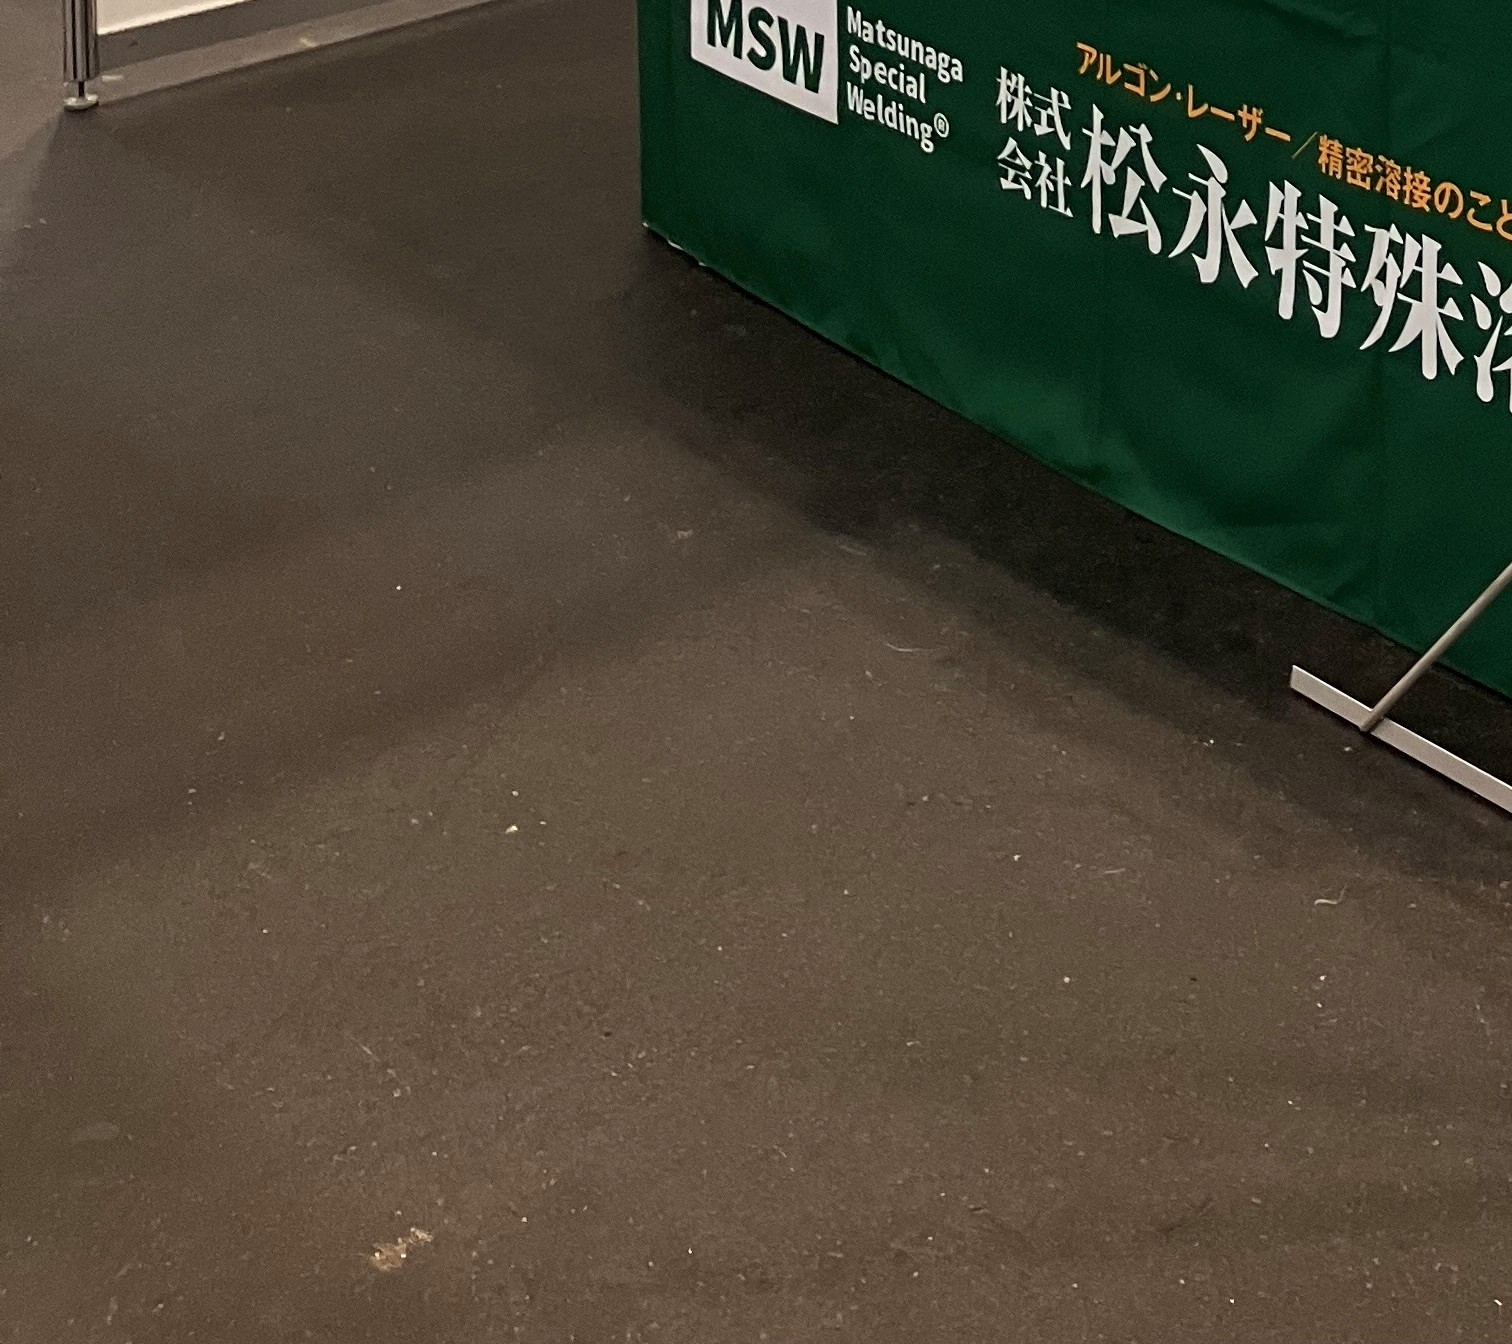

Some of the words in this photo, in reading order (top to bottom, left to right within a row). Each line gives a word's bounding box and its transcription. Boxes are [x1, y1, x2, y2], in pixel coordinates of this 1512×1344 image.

[846, 6, 964, 83] Matsunaga
[848, 45, 926, 104] Special
[996, 66, 1071, 151] 株式
[996, 138, 1073, 219] 会社
